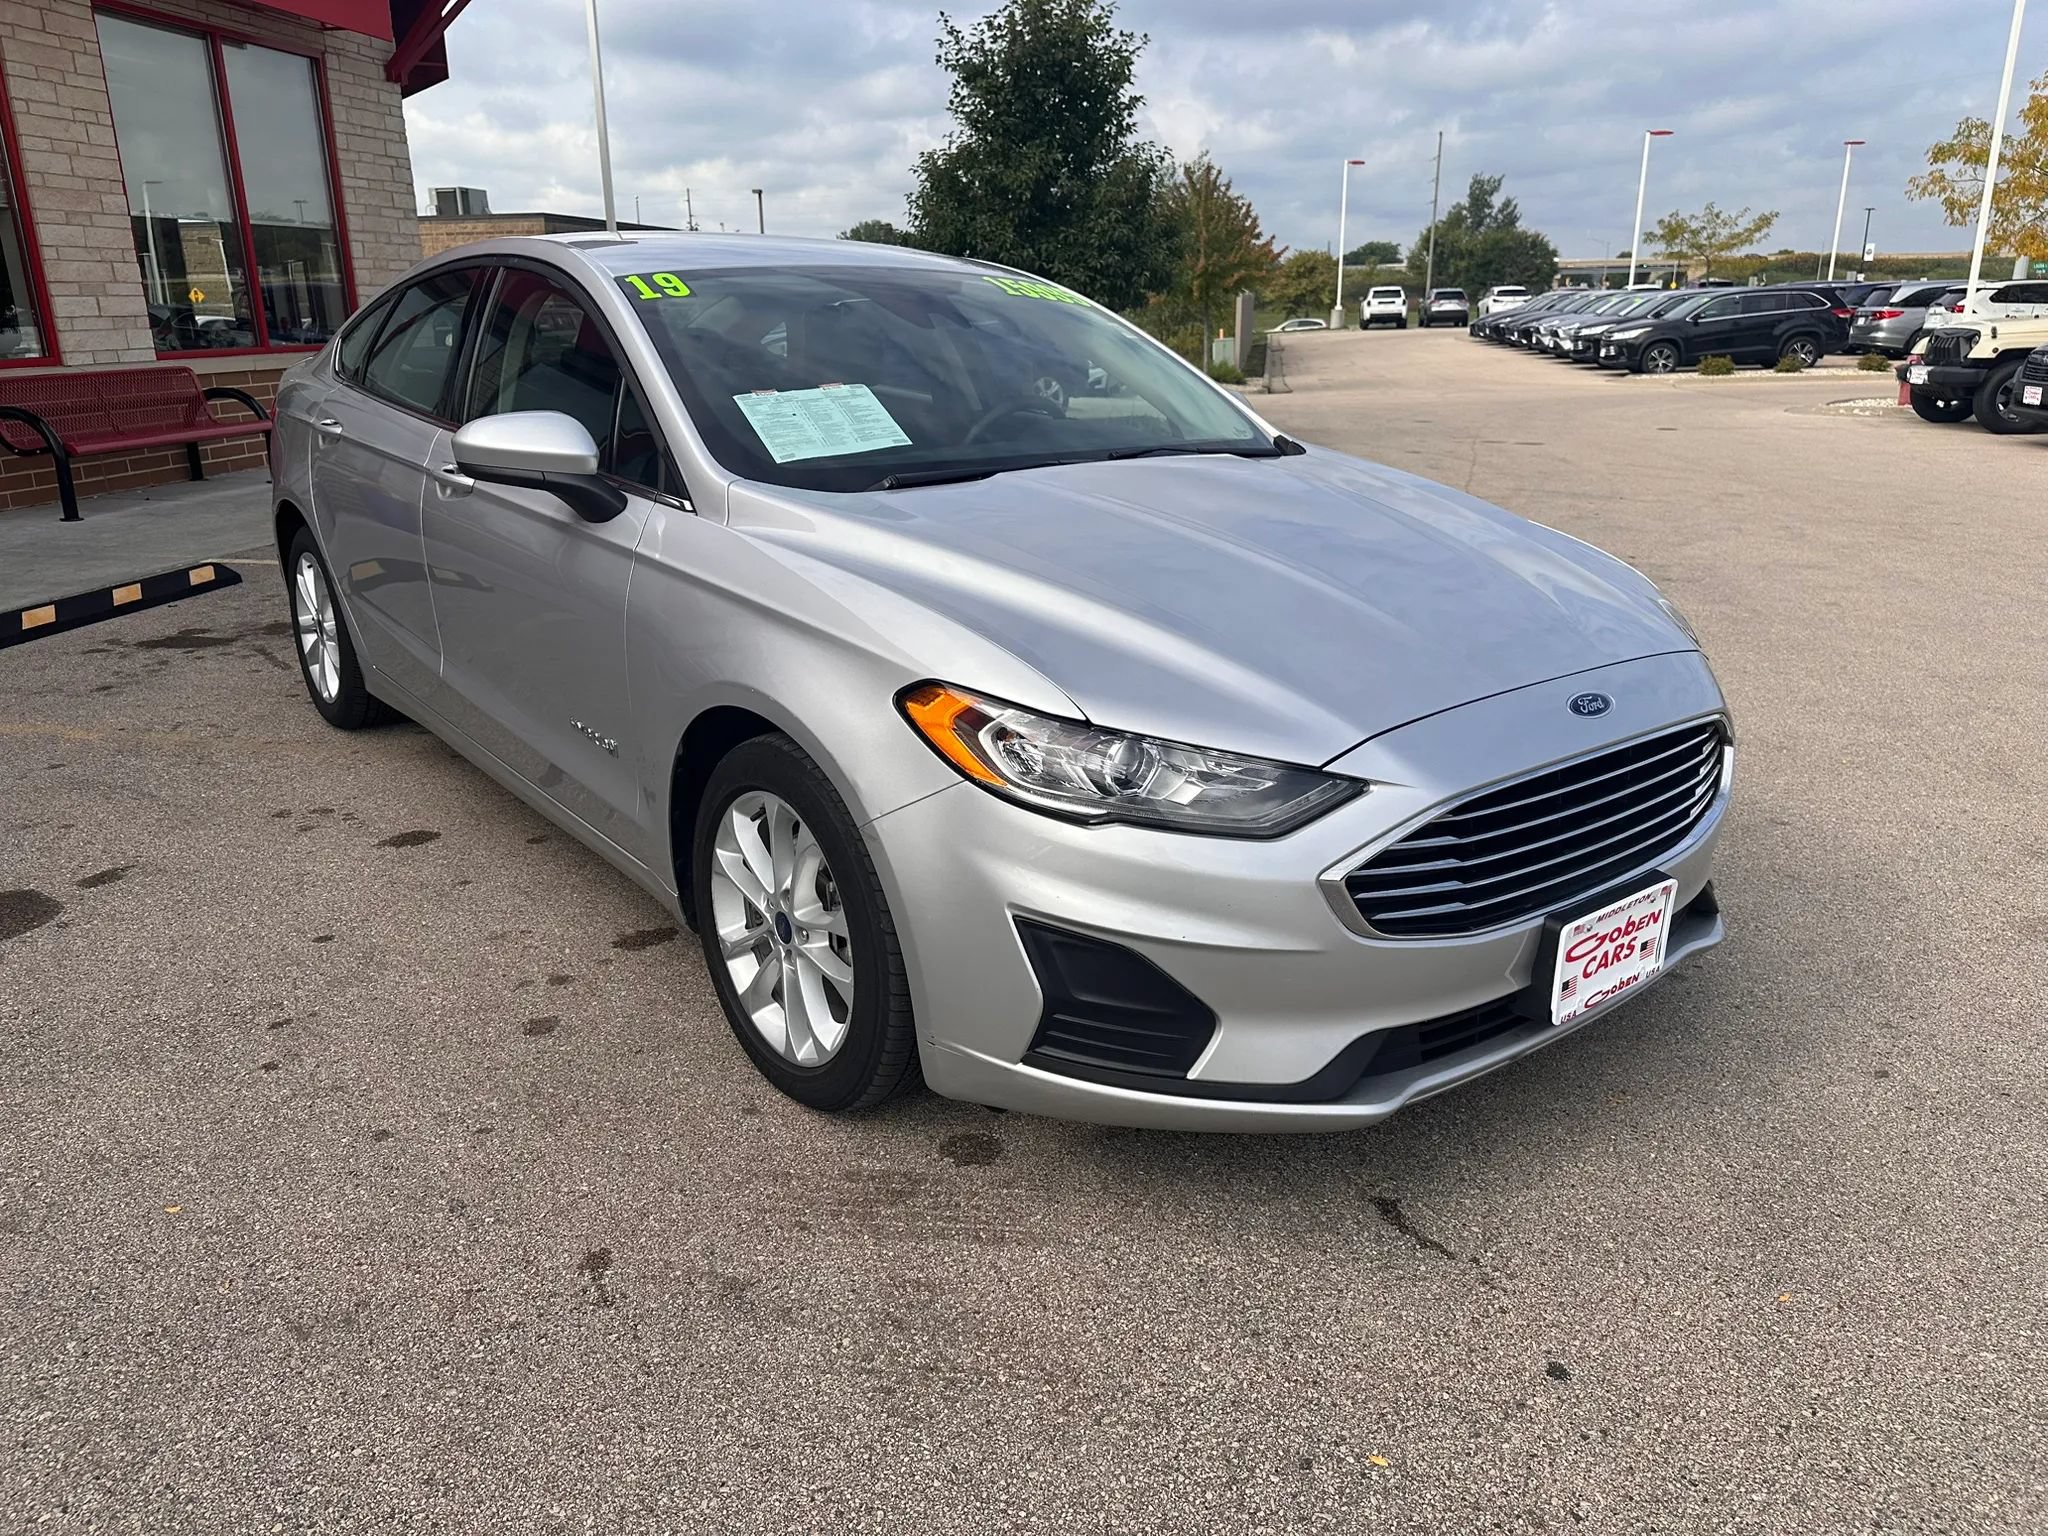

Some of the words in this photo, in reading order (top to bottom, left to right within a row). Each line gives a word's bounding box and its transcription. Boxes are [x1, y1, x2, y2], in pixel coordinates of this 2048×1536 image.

[624, 272, 691, 300] 19
[1577, 696, 1605, 713] Ford
[1596, 893, 1652, 924] MIDDLETON
[1582, 936, 1638, 979] CARS
[1560, 1009, 1578, 1024] USA
[1645, 965, 1661, 978] USA
